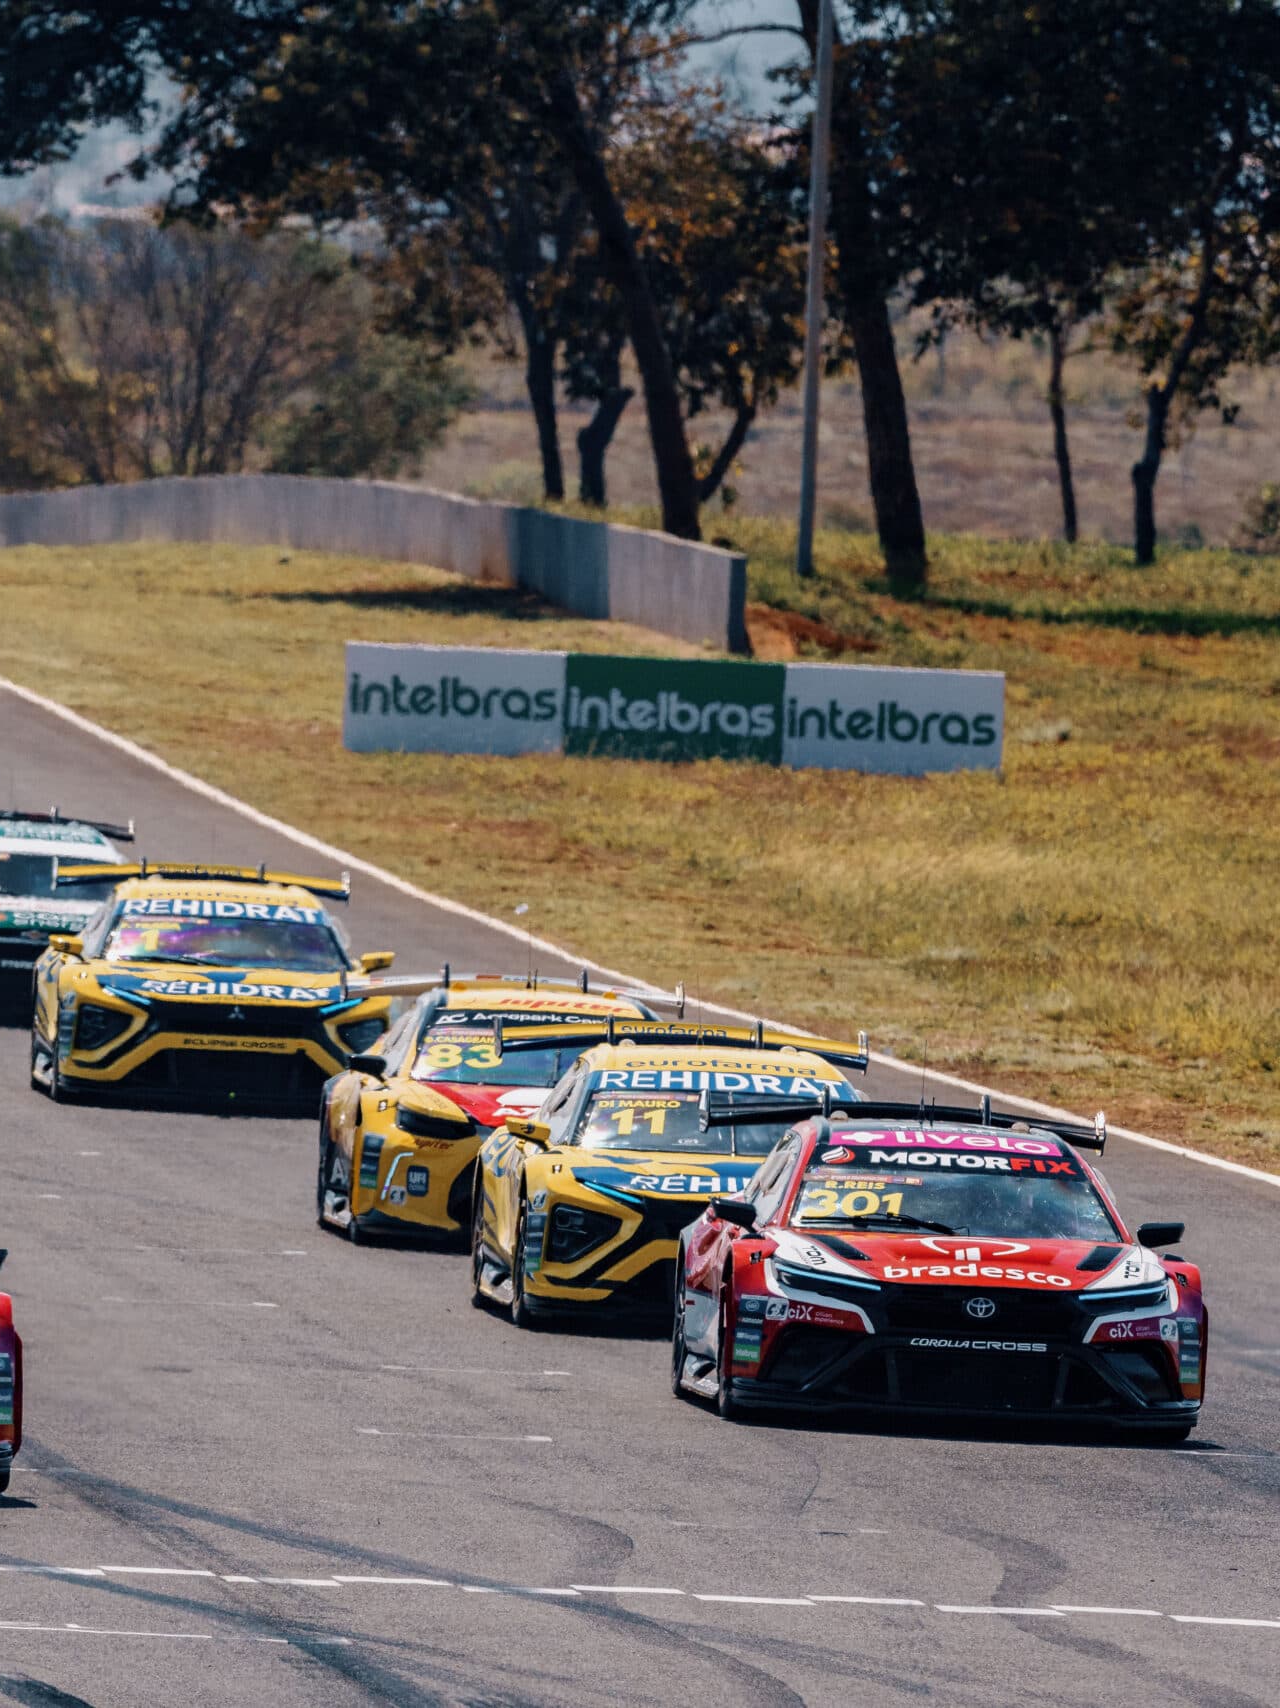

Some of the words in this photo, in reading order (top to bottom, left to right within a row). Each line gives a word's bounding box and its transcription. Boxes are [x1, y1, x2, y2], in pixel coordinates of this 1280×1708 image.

[350, 673, 557, 722] intelbras
[570, 689, 776, 737] intelbras
[787, 698, 997, 747] intelbras
[141, 929, 160, 951] 1
[427, 1044, 504, 1069] 83
[626, 1059, 817, 1077] eurofarma
[598, 1101, 617, 1109] DI
[618, 1099, 681, 1109] MAURO
[611, 1108, 668, 1136] 11
[869, 1150, 1078, 1176] MOTORFIX
[825, 1180, 887, 1191] R.REIS
[801, 1190, 905, 1219] 301
[883, 1263, 1072, 1287] bradesco
[910, 1337, 970, 1349] COROLLA
[971, 1340, 1048, 1352] CROSS
